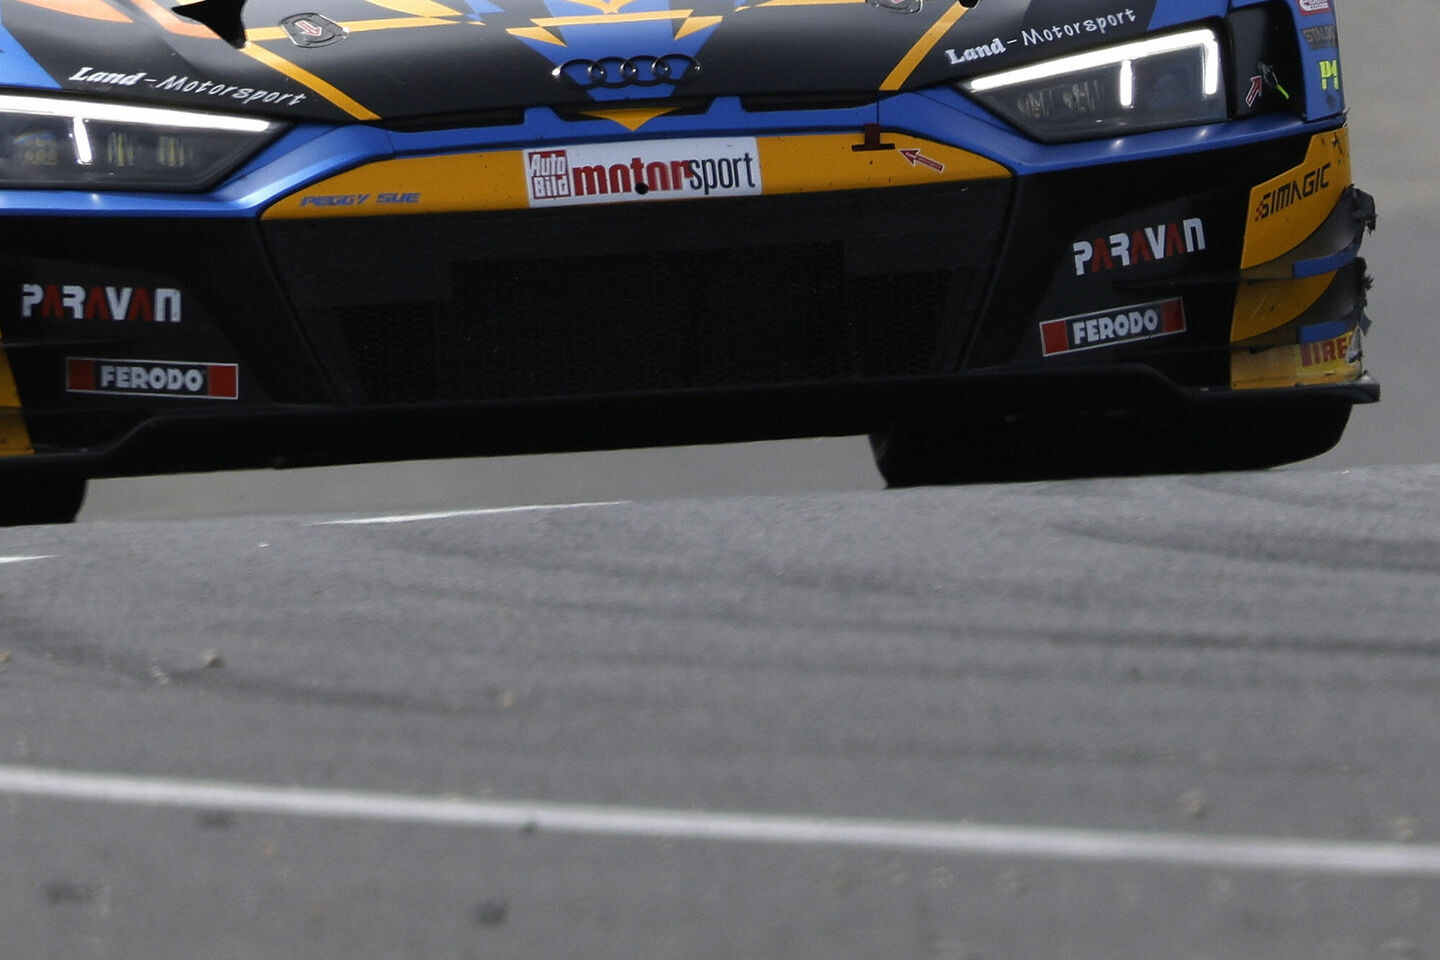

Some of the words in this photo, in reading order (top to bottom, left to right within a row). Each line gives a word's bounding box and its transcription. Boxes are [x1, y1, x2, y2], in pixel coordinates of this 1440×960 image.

[529, 153, 568, 177] Auto
[299, 193, 369, 207] PEGGY
[375, 191, 422, 204] SUE
[532, 176, 571, 198] Bild
[1256, 162, 1331, 220] SIMAGIC
[1073, 217, 1206, 276] PARAVAN
[21, 283, 182, 324] PARAVAN
[1073, 309, 1159, 345] FERODO
[100, 364, 205, 392] FERODO
